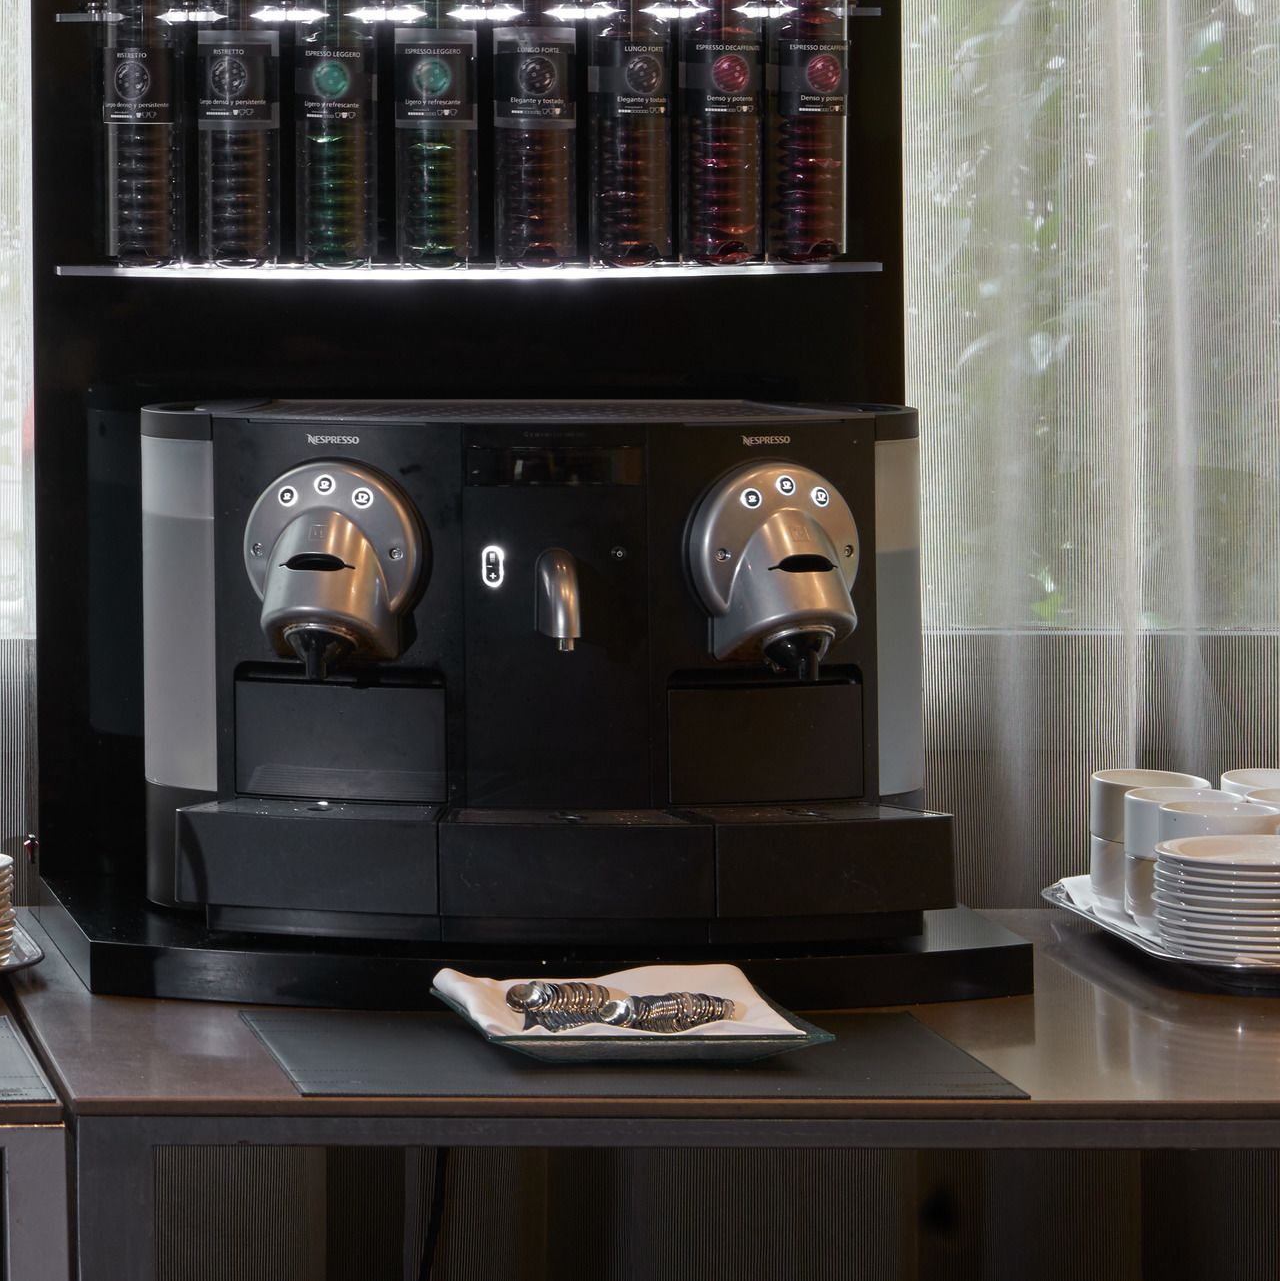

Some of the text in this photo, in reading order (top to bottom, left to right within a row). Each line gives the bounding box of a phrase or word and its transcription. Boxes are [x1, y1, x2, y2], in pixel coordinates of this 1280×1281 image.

[510, 97, 537, 105] Elegante
[617, 96, 644, 104] Elegante
[306, 433, 360, 445] NESPRESSO
[741, 435, 791, 446] NESPRESSO
